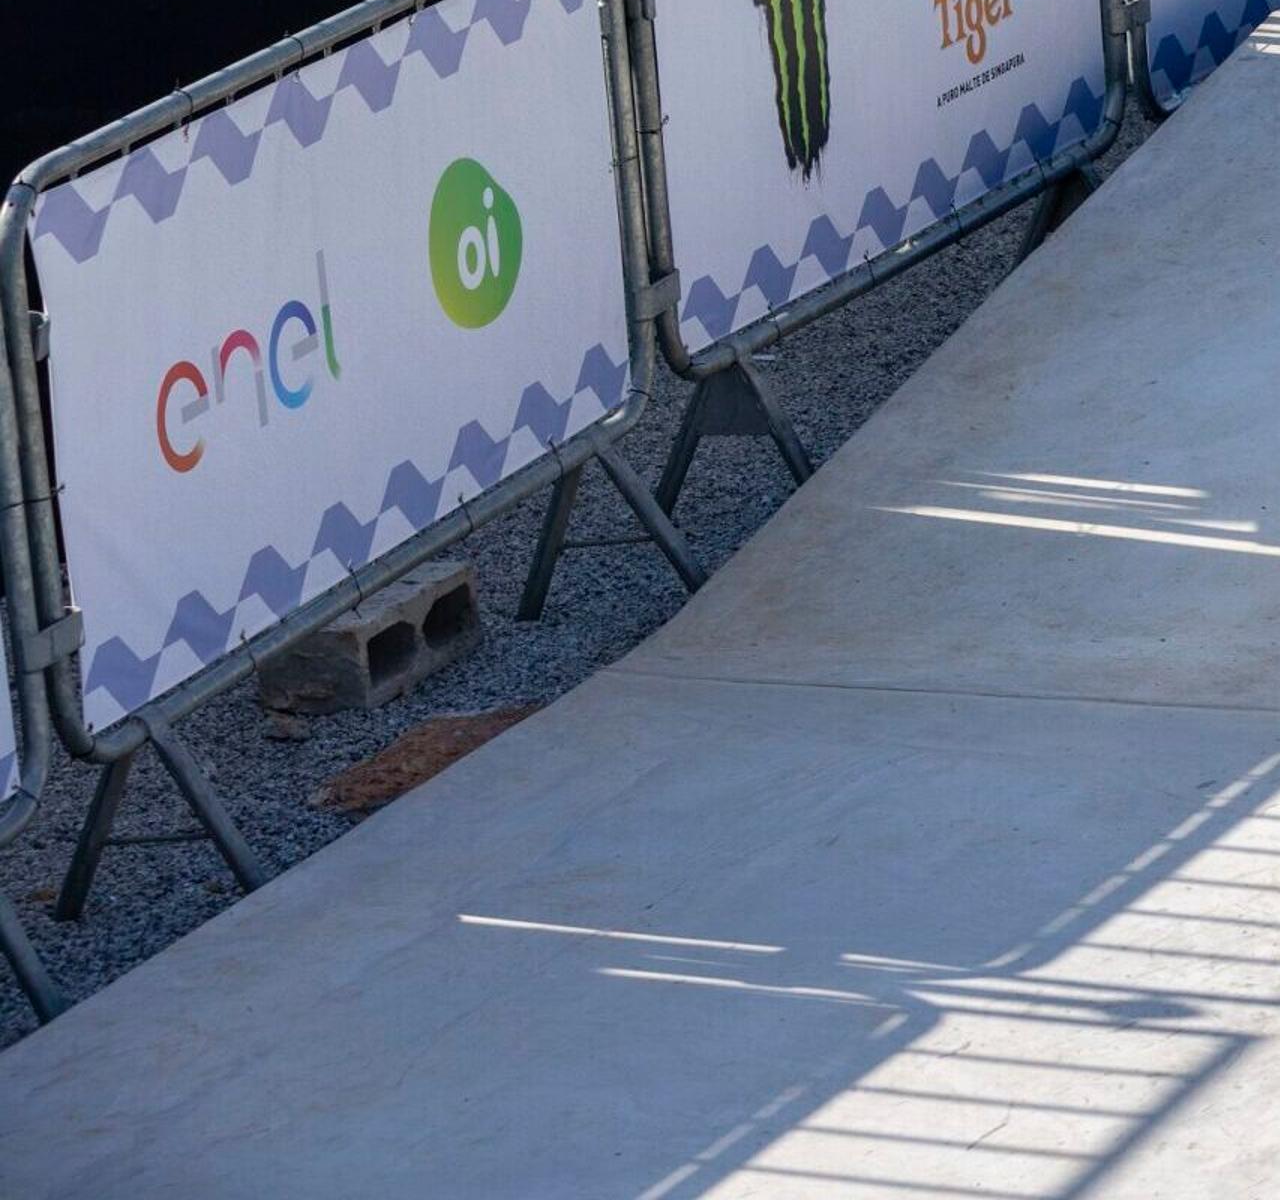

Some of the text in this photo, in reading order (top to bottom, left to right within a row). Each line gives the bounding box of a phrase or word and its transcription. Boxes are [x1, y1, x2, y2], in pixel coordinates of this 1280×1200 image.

[942, 85, 959, 106] PURO
[959, 76, 981, 98] MALTE
[990, 51, 1026, 81] SINGAPURA
[457, 186, 502, 291] oi
[156, 248, 343, 474] enel
